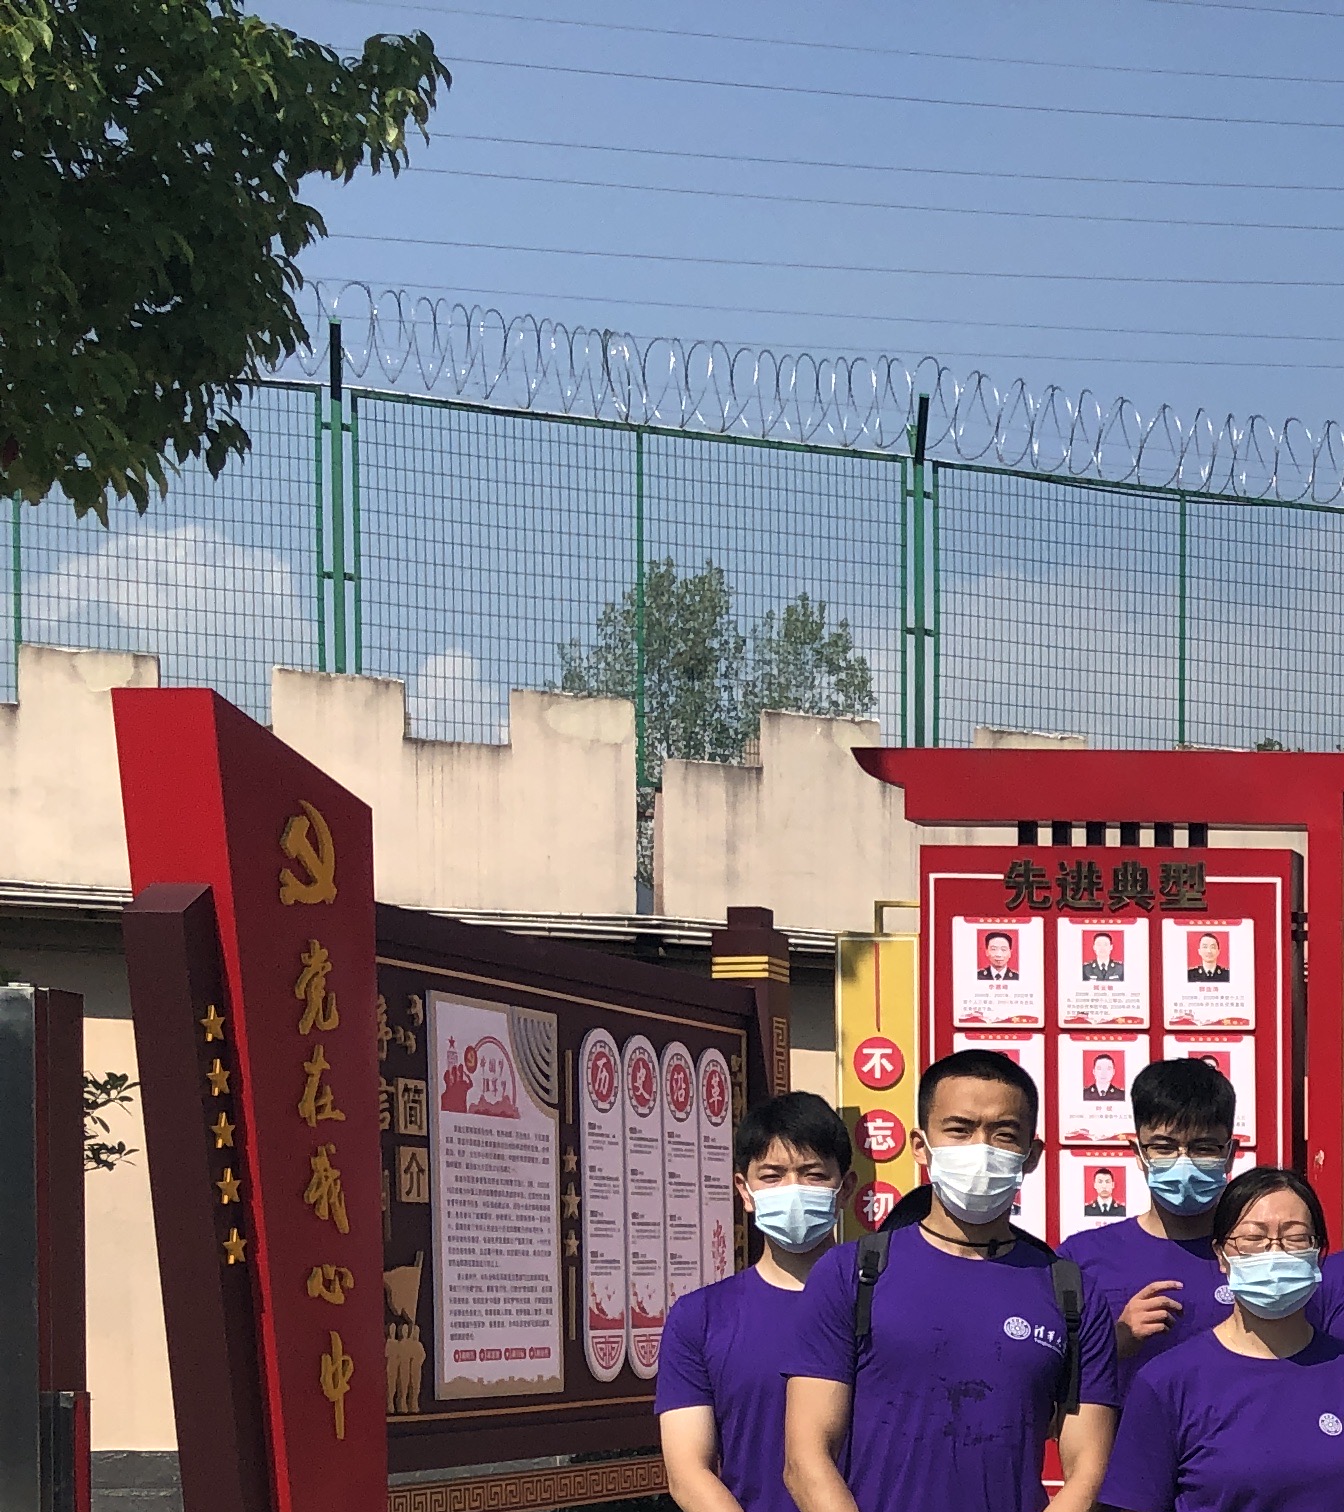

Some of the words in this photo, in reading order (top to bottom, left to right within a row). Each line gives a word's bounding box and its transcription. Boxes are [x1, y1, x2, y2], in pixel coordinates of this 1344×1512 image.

[1004, 858, 1208, 912] 先进典型
[294, 938, 357, 1441] 党在我心中
